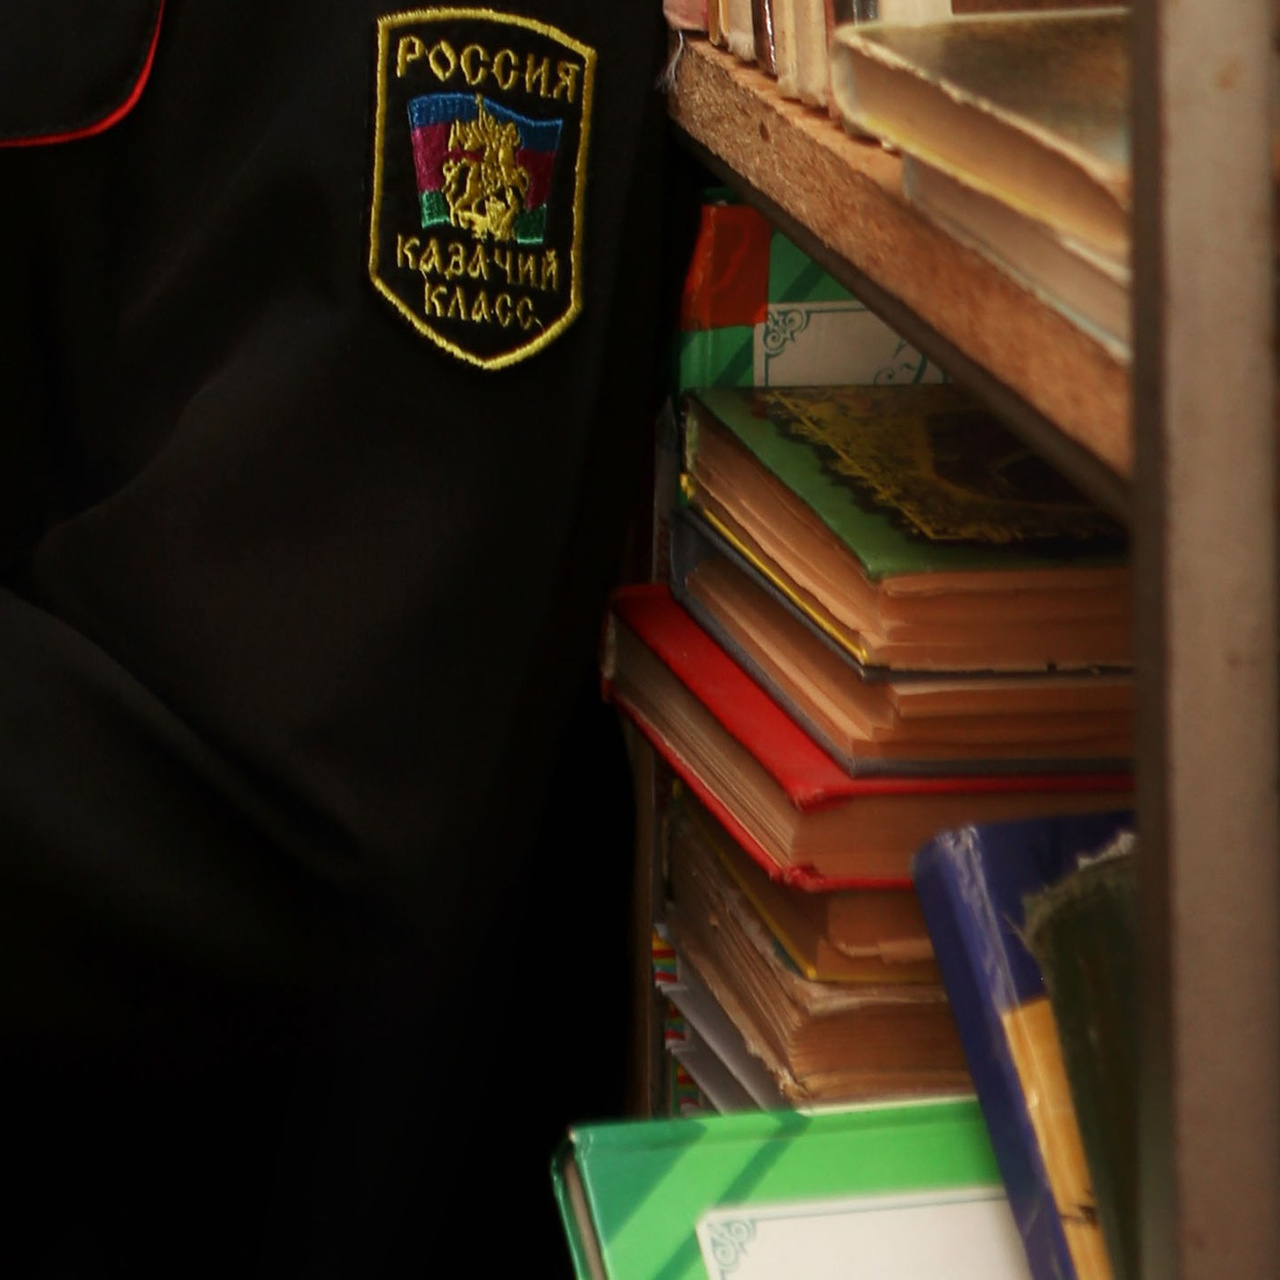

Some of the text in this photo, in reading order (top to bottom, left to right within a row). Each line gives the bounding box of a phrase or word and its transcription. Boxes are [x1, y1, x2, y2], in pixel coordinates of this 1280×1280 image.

[396, 34, 580, 104] РОССИЯ
[396, 233, 560, 291] КАЗАЧИЙ
[424, 284, 536, 330] КЛАСС
